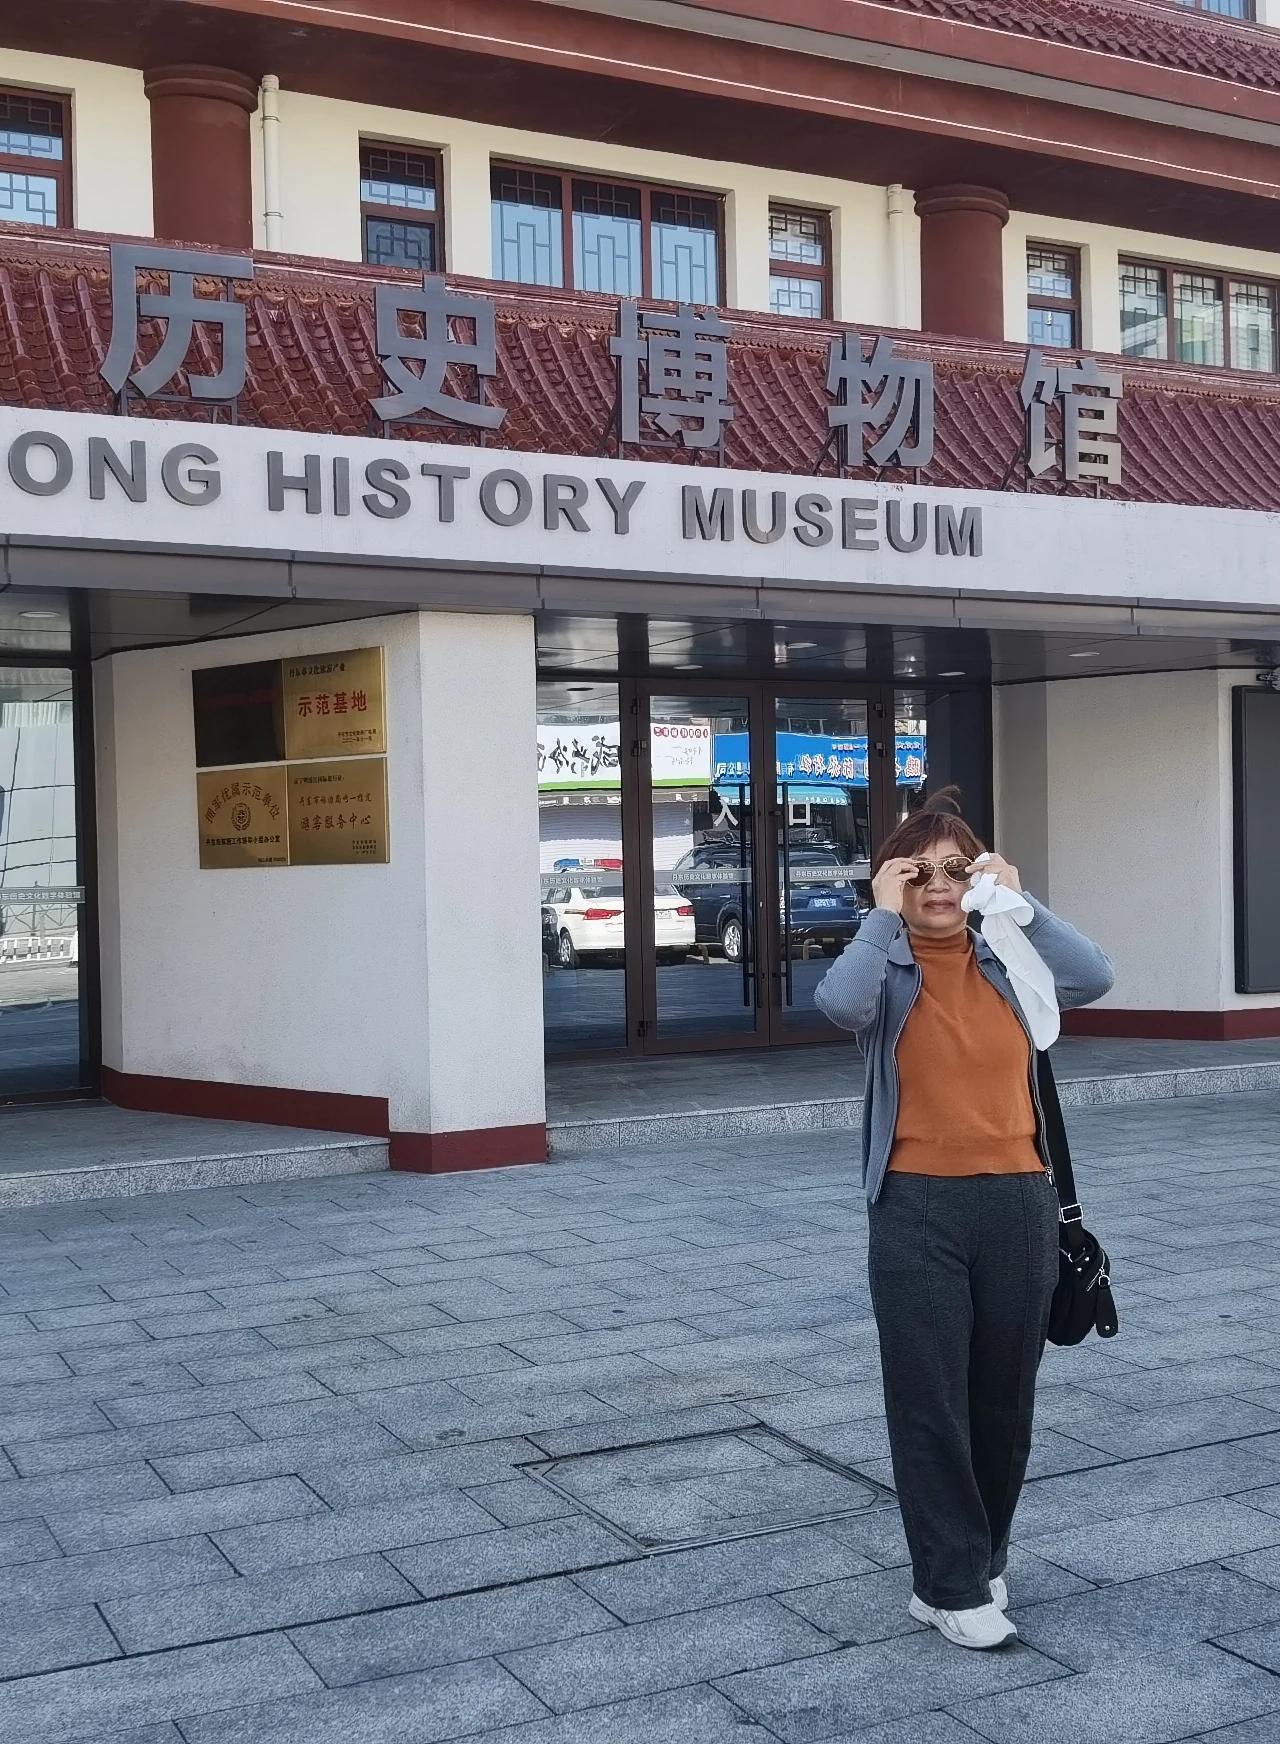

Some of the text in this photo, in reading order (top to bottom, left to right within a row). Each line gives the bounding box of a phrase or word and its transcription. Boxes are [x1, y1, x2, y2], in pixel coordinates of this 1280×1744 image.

[267, 450, 646, 535] HISTORY
[681, 484, 984, 558] MUSEUM
[298, 690, 369, 718] 示范基地
